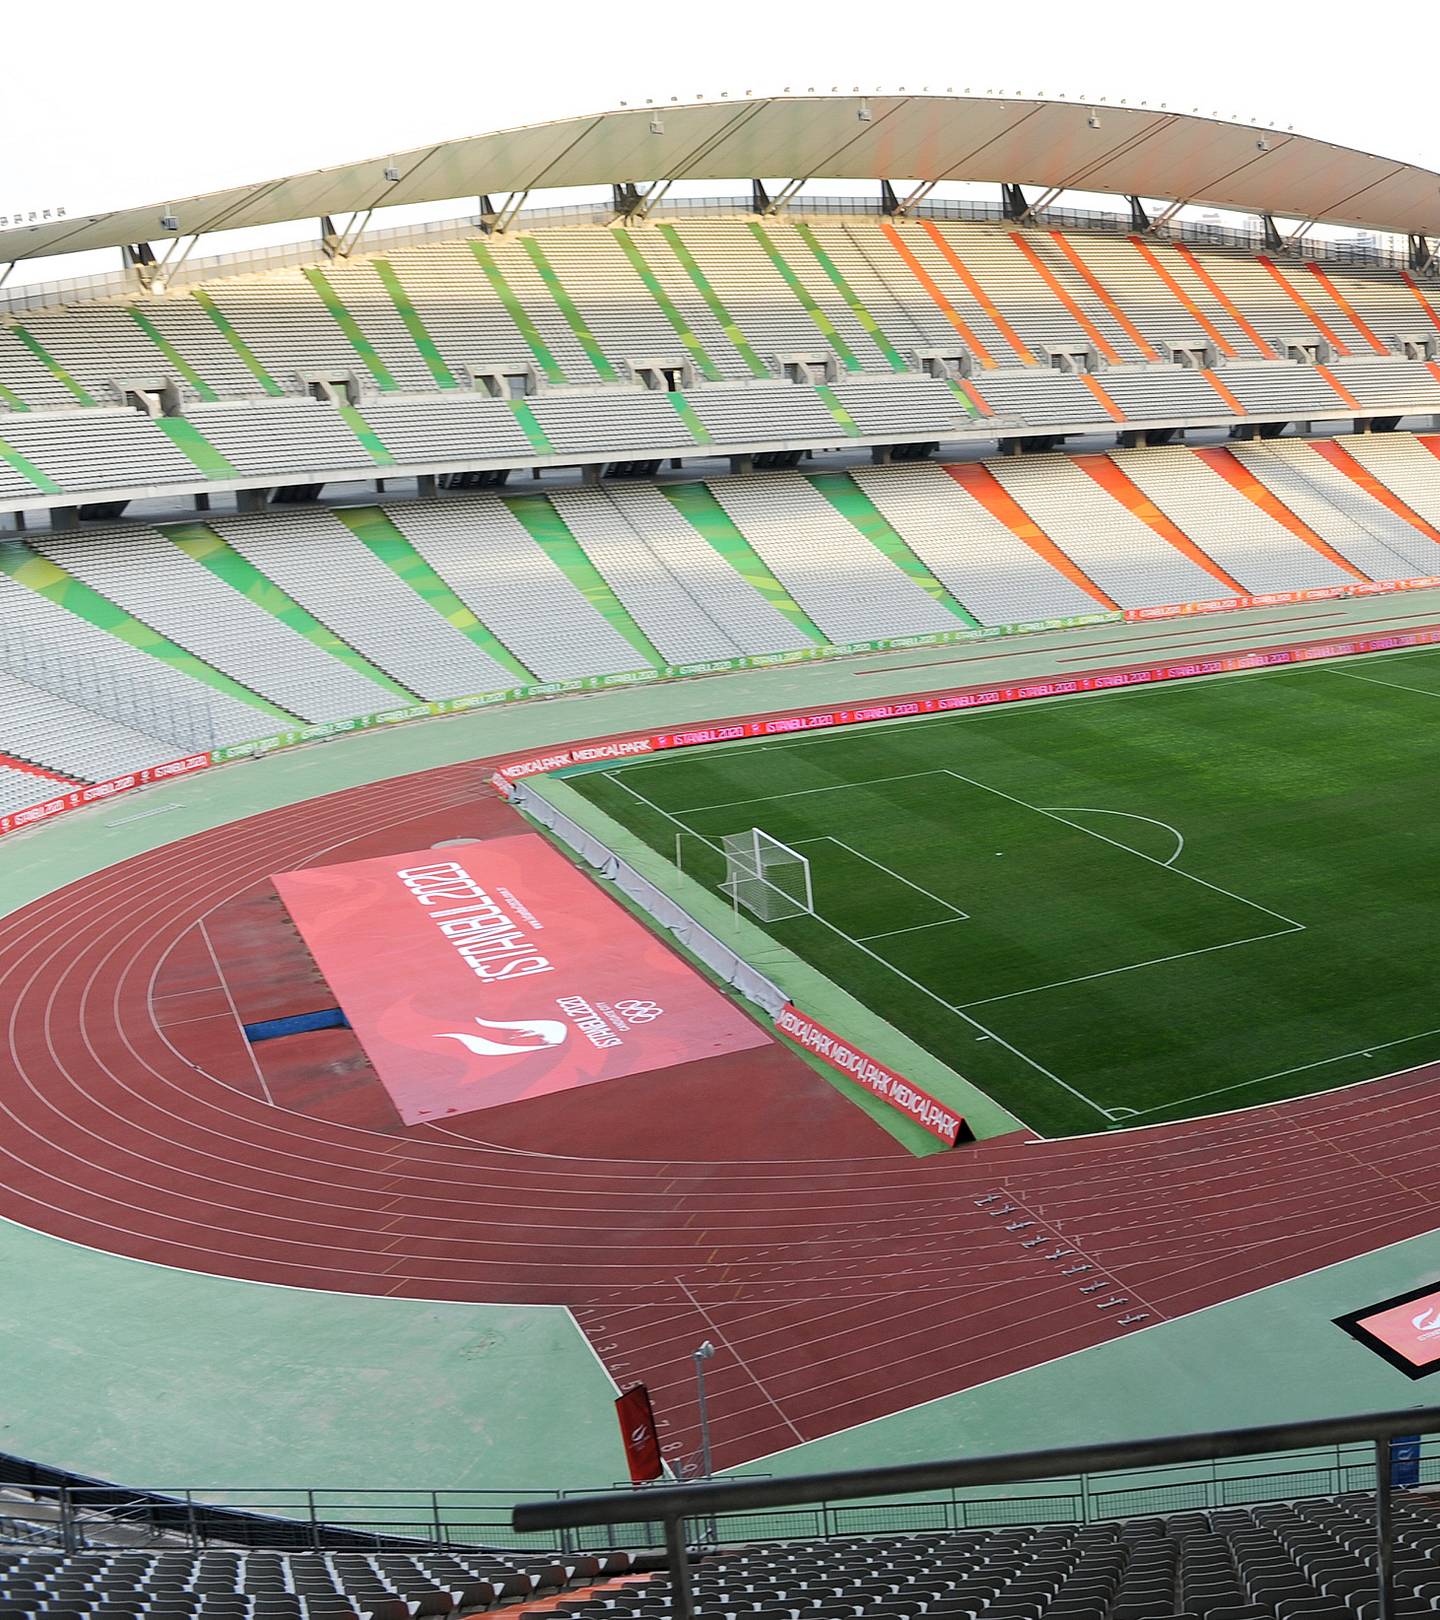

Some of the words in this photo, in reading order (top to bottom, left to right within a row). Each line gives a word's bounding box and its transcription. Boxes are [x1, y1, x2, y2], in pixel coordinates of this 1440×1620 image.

[397, 861, 486, 906] 2020
[556, 995, 593, 1017] 2020
[586, 1325, 606, 1334] 2
[599, 1342, 618, 1353] 3
[610, 1361, 631, 1371] 4
[661, 1441, 683, 1453] 8
